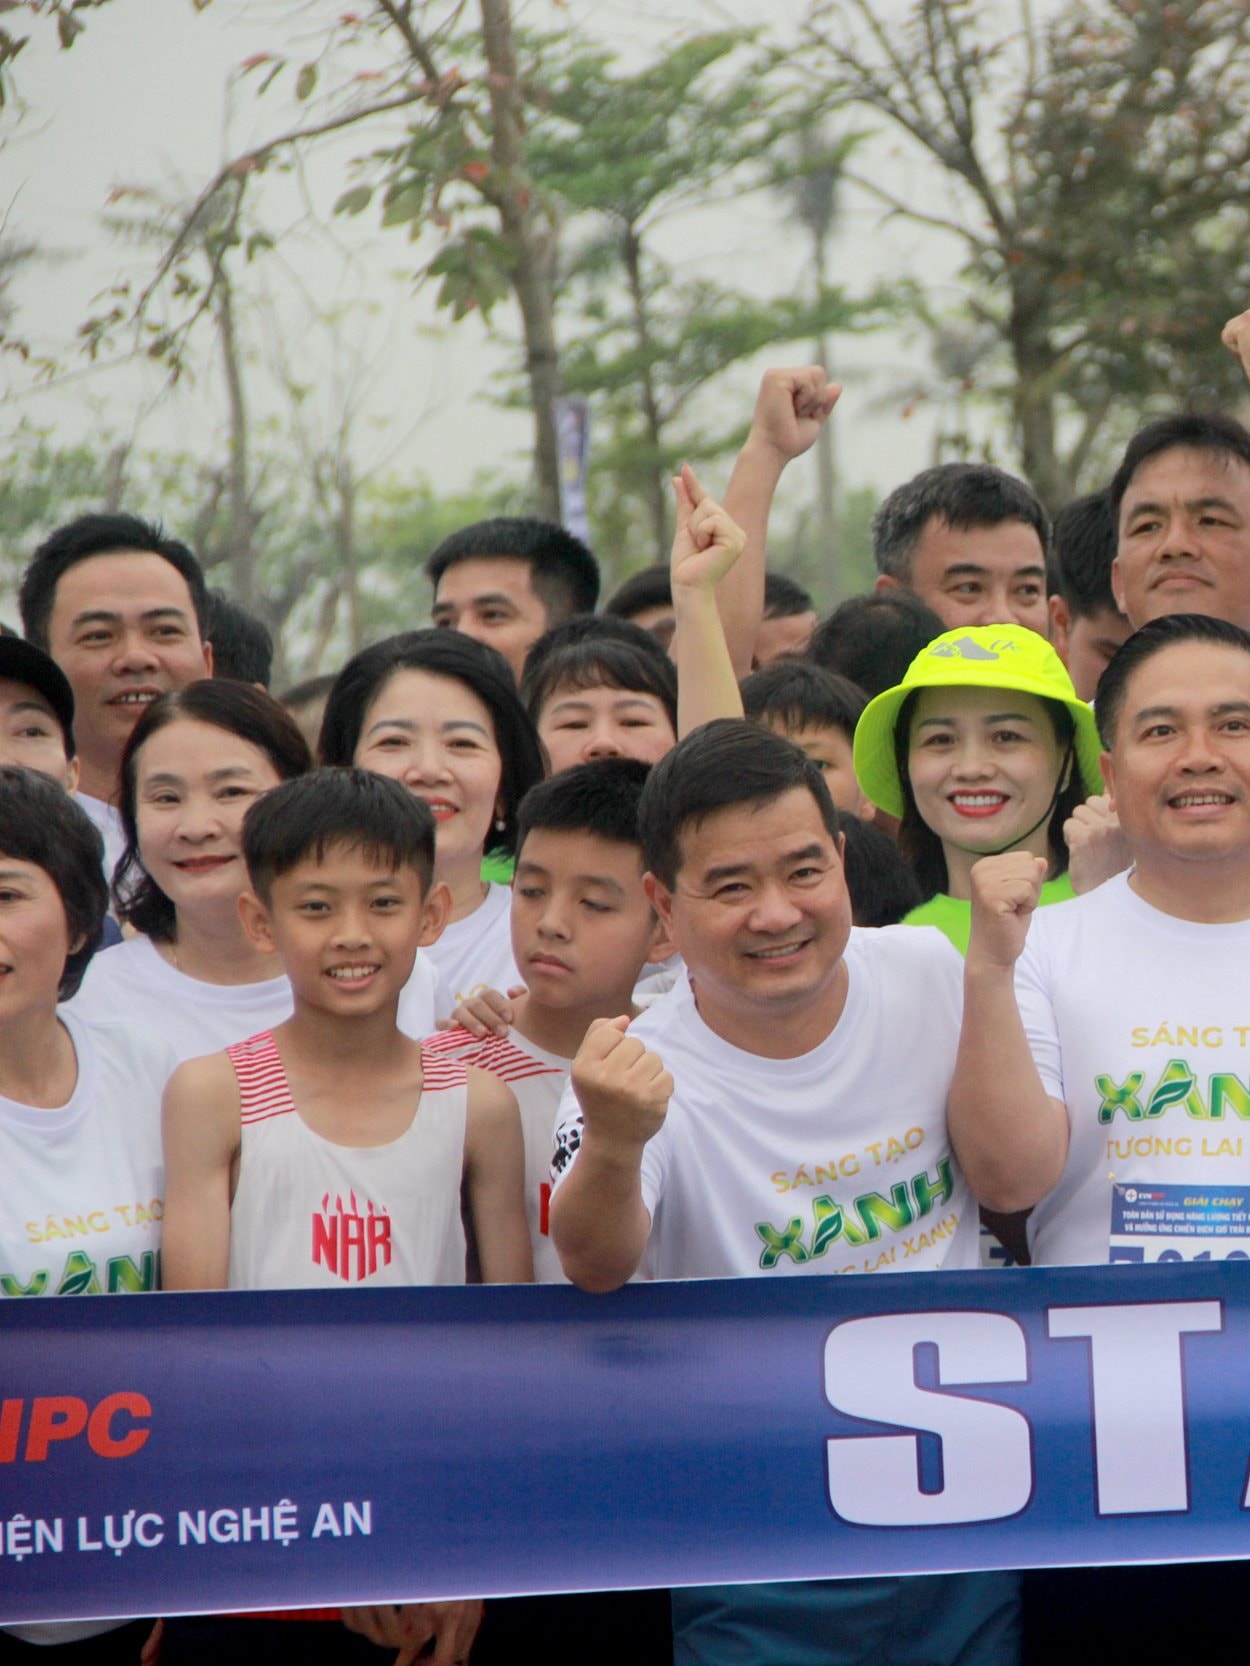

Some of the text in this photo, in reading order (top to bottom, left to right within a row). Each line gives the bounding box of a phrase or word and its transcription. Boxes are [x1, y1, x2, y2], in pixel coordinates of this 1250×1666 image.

[1131, 1021, 1224, 1049] SÁNG
[771, 1126, 926, 1194] SÁNG TẠO
[1107, 1135, 1192, 1160] TƯƠNG
[1201, 1137, 1242, 1157] LAI
[25, 1198, 164, 1244] SÁNG TẠO
[901, 1214, 960, 1258] XANH
[312, 1211, 392, 1282] NAR
[78, 1509, 164, 1557] LỰC
[178, 1498, 299, 1547] NGHỆ
[312, 1501, 371, 1539] AN
